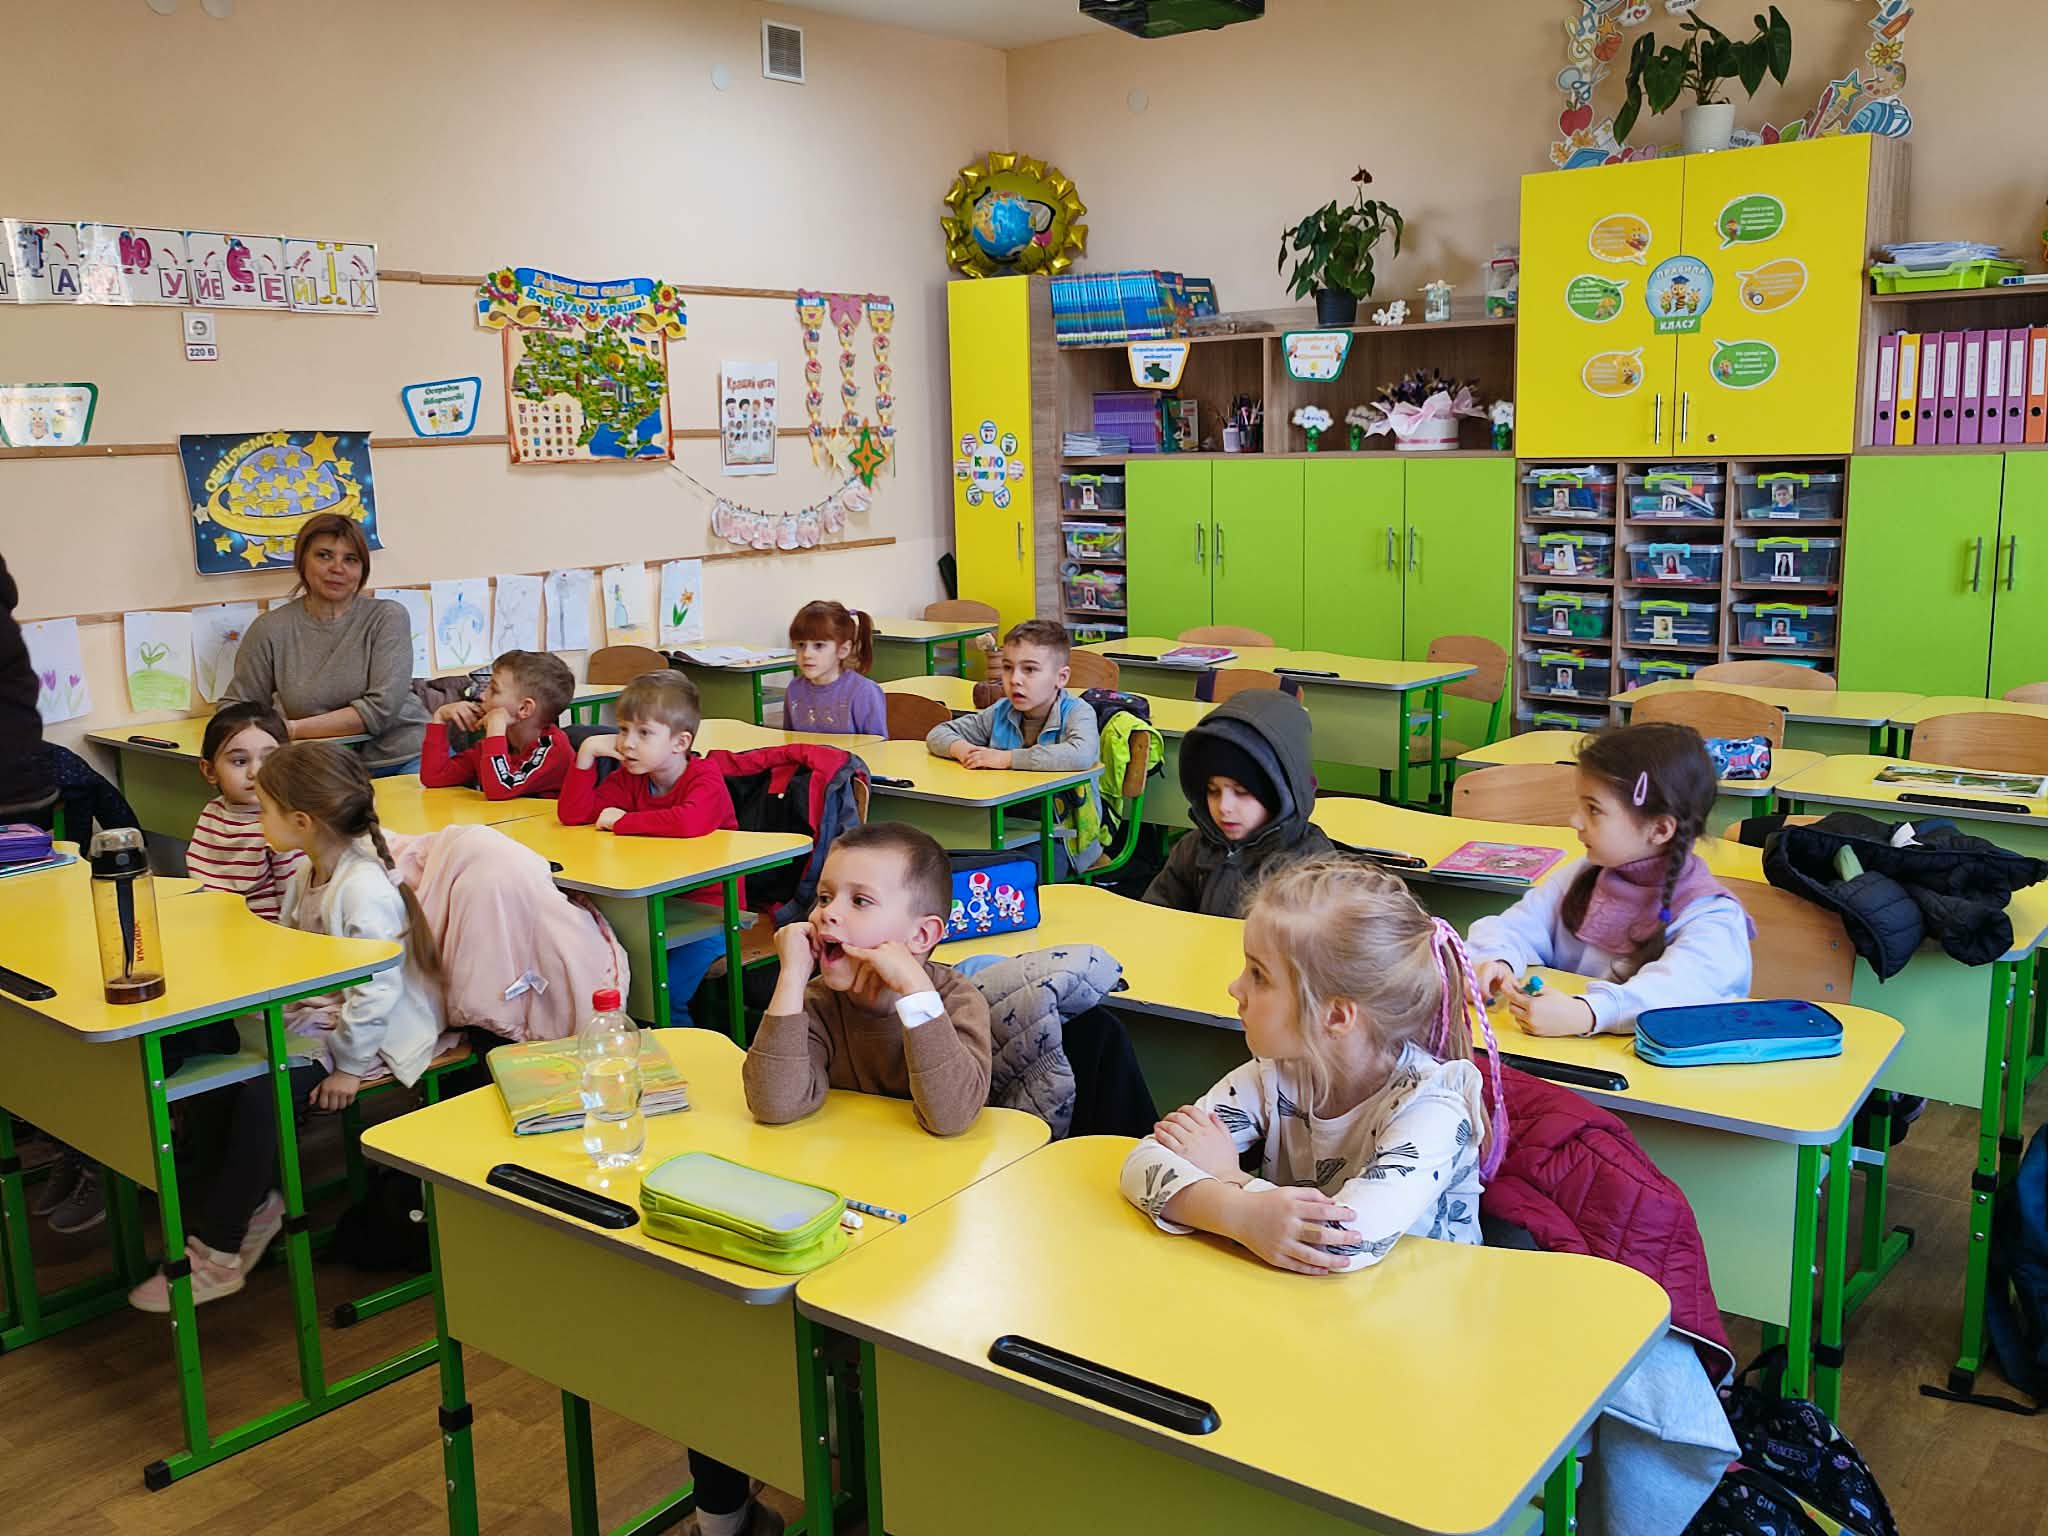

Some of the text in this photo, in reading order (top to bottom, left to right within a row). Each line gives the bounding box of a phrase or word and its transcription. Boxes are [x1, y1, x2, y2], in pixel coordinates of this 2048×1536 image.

[163, 272, 184, 297] У
[197, 271, 222, 298] ЙЕ
[263, 278, 285, 301] Е
[525, 287, 647, 316] Все буде Україна!
[1659, 319, 1696, 331] КЛАСУ
[189, 347, 206, 358] 220
